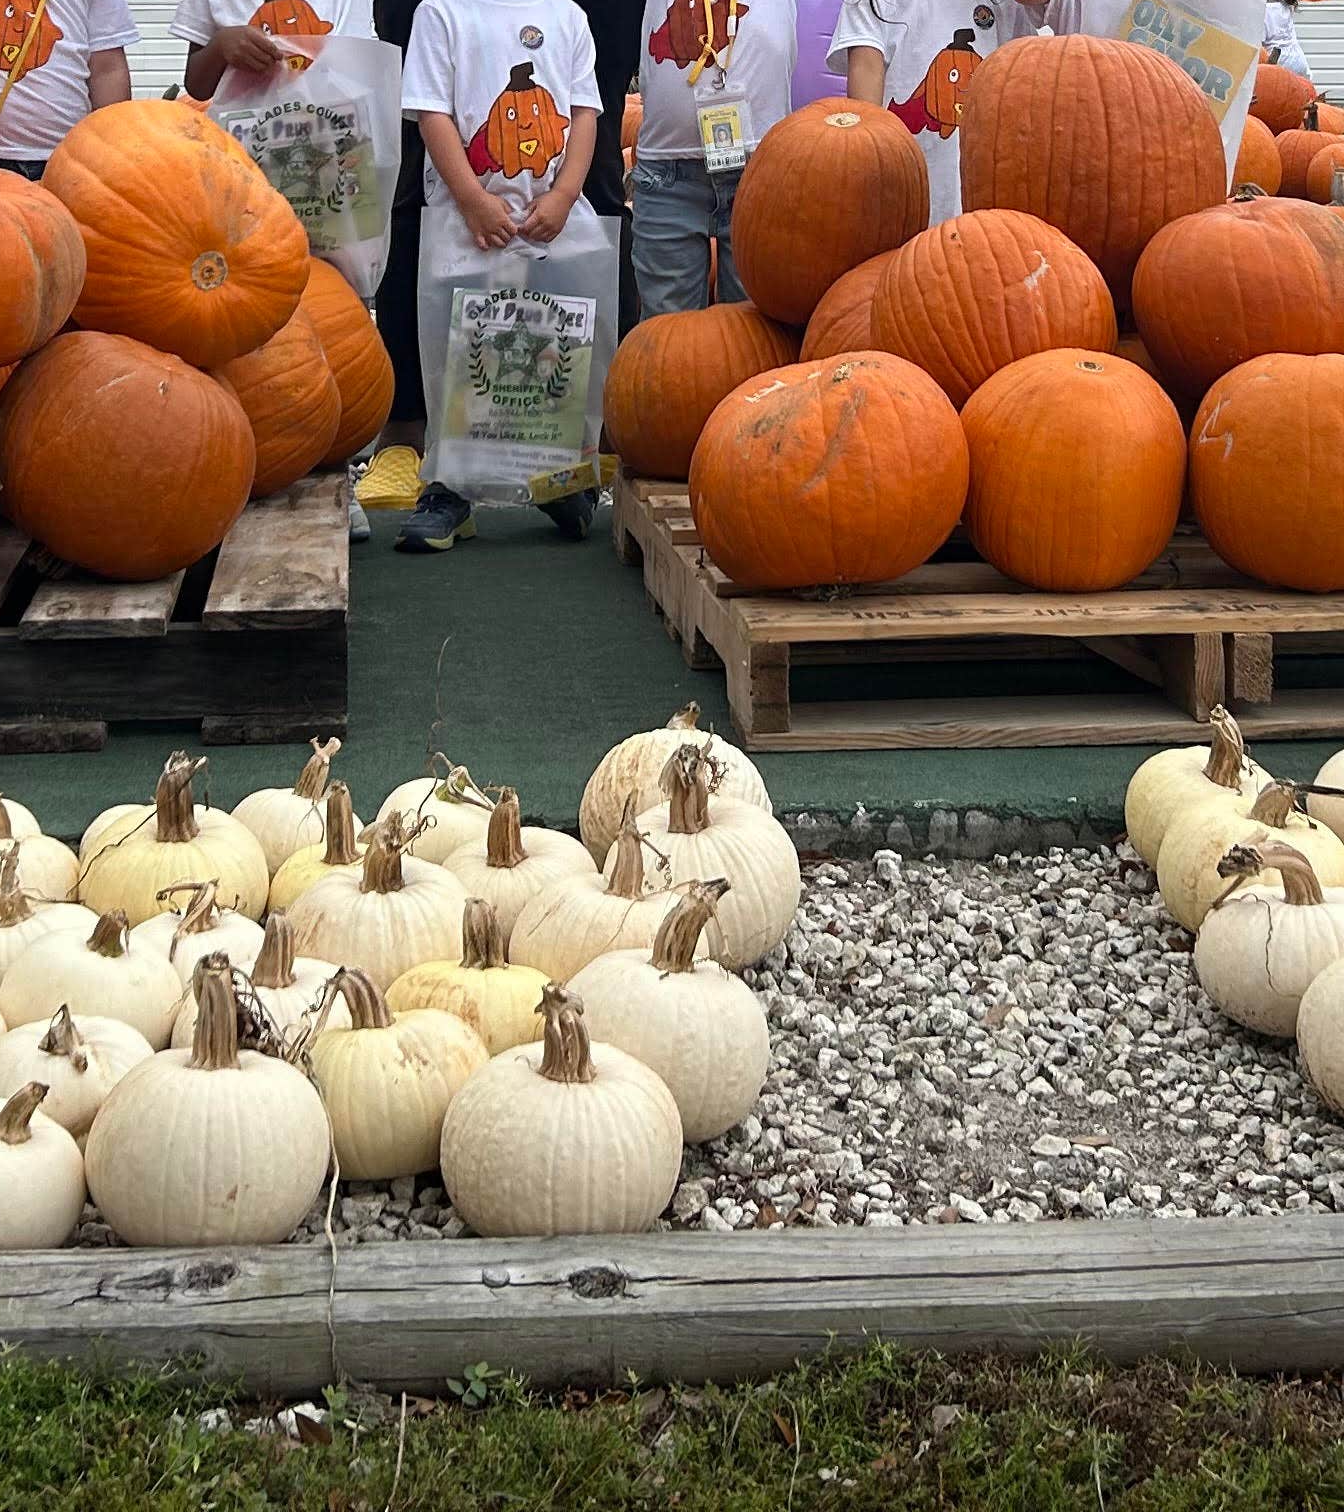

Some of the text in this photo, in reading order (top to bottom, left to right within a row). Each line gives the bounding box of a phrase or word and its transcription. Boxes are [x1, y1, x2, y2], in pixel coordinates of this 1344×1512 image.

[1133, 0, 1205, 51] OLLY
[468, 288, 518, 320] GLADES
[492, 394, 542, 407] OFFICE
